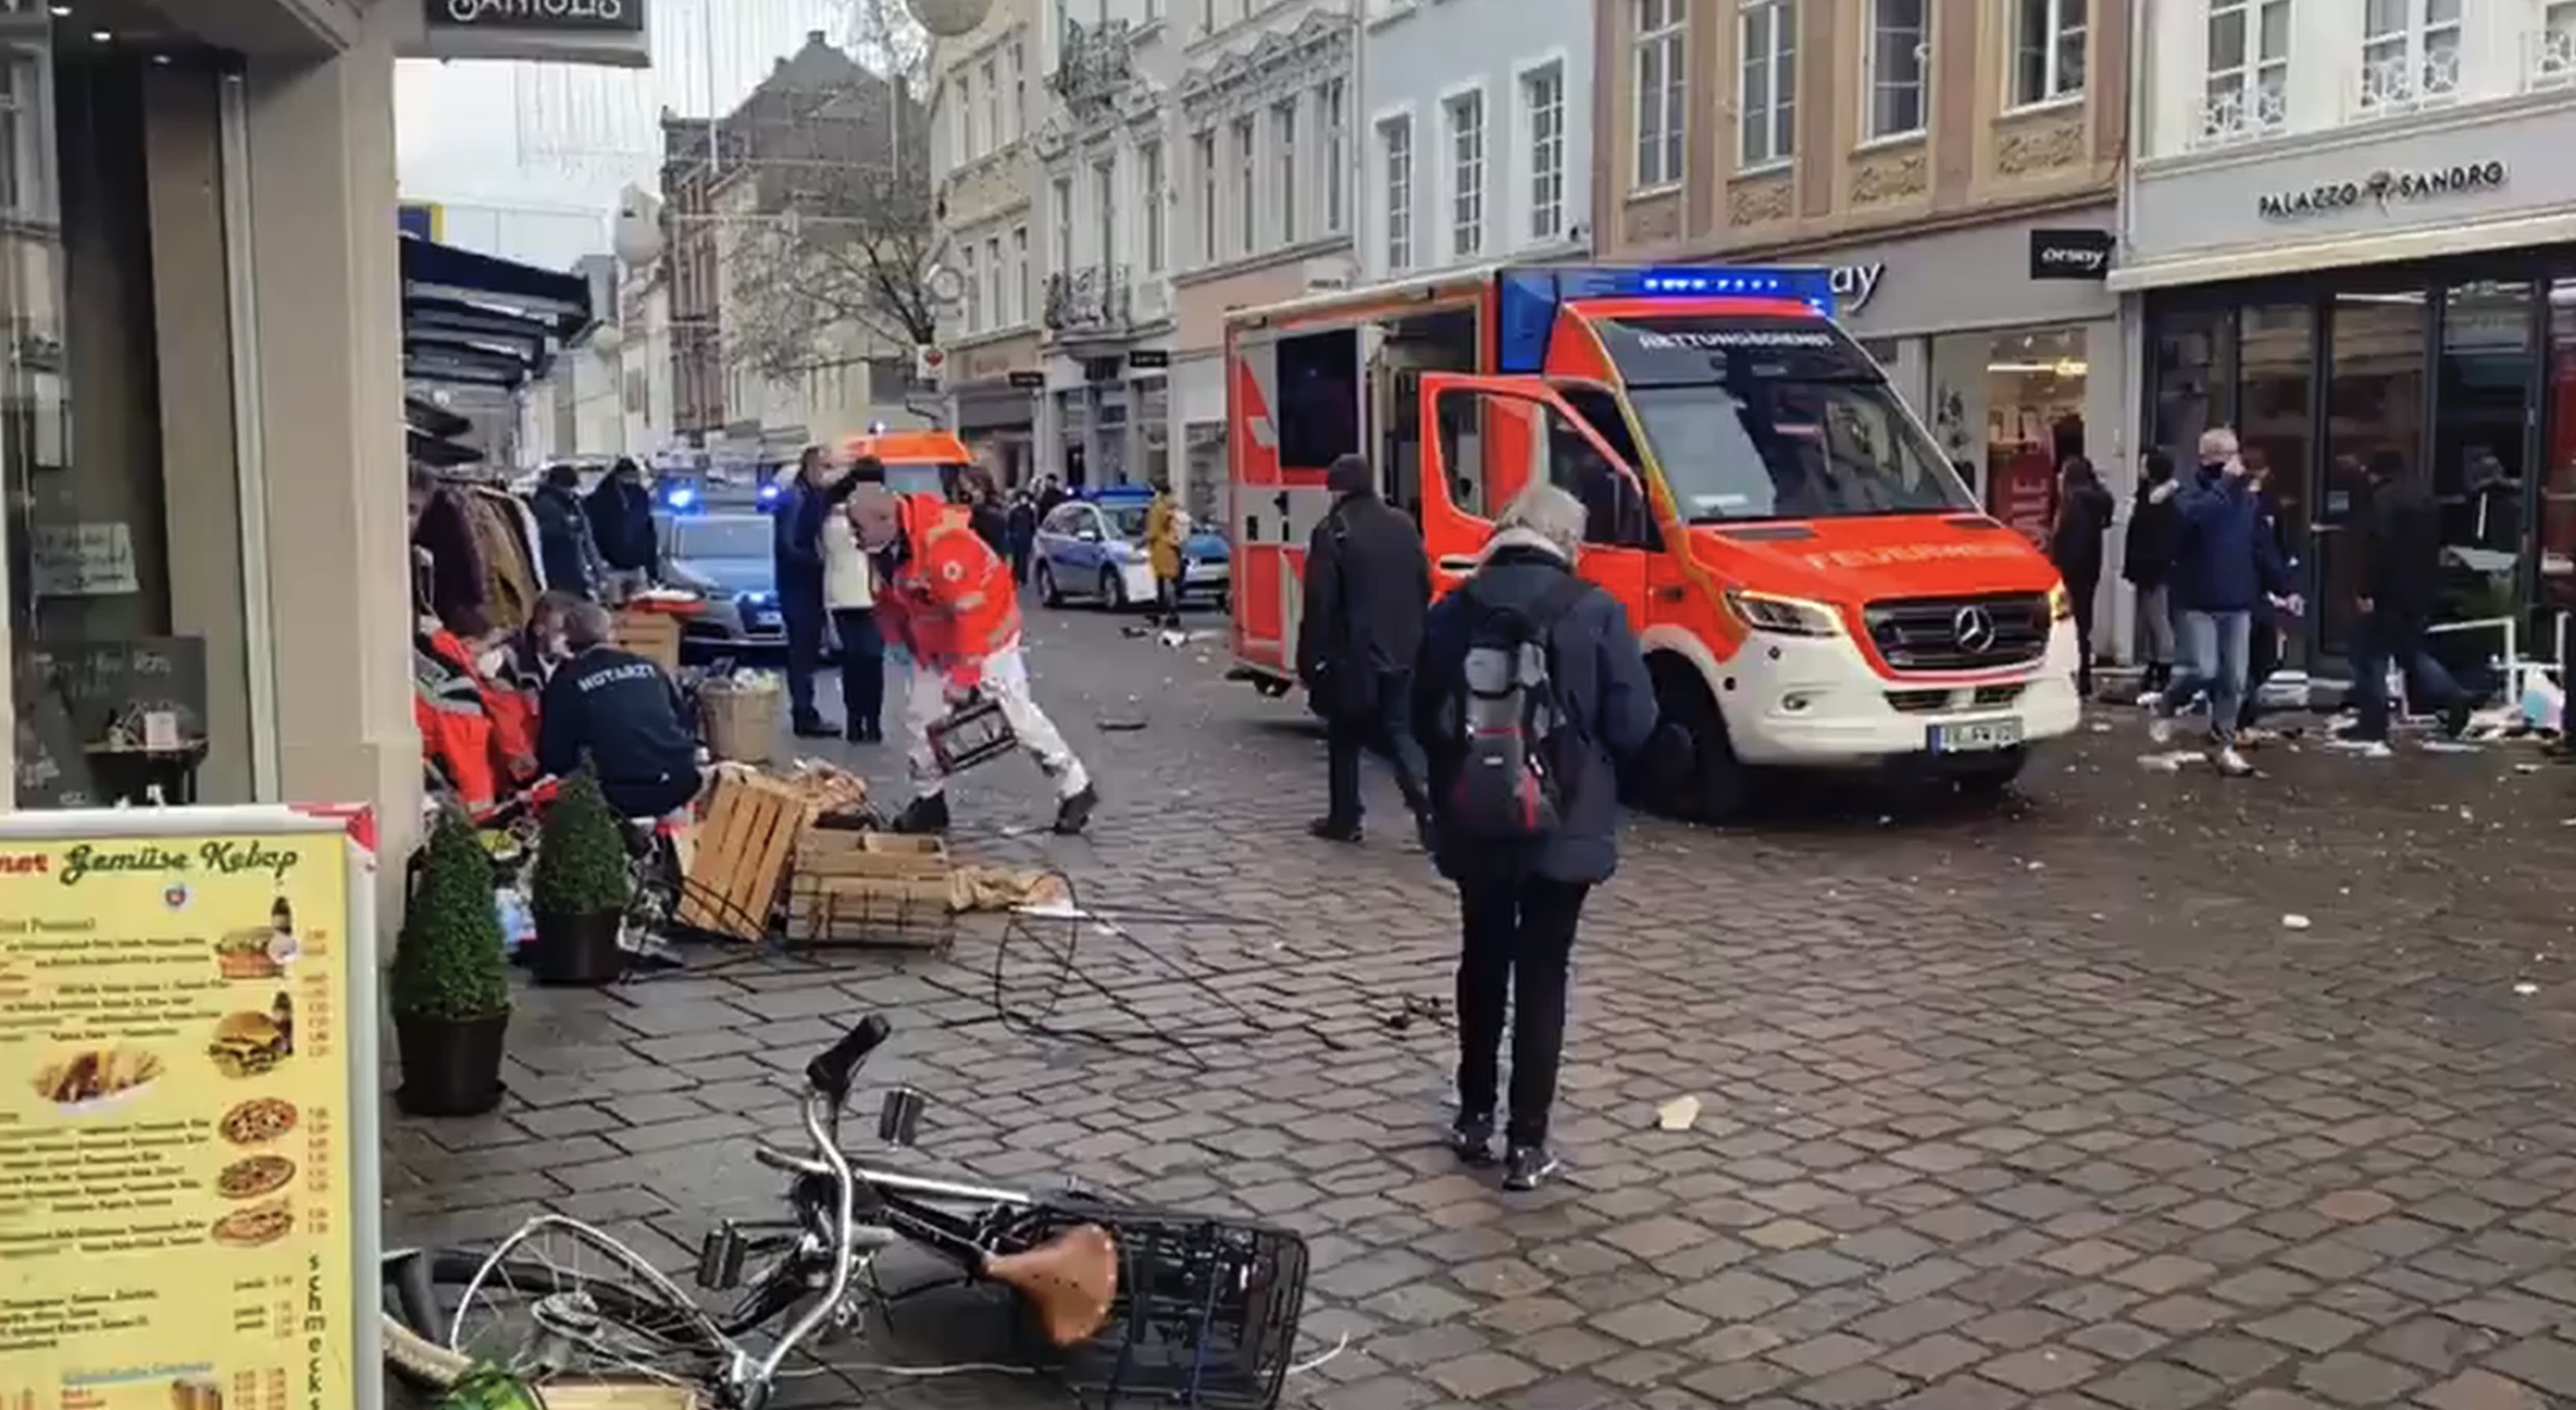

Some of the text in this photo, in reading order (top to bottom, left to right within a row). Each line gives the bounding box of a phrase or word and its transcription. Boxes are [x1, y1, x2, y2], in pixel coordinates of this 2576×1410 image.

[2258, 161, 2505, 218] PALAZZO SANDRO
[2041, 246, 2105, 270] orsay
[576, 663, 657, 693] NOTARZT
[60, 844, 187, 885] Gemüse
[199, 840, 299, 879] Kebap
